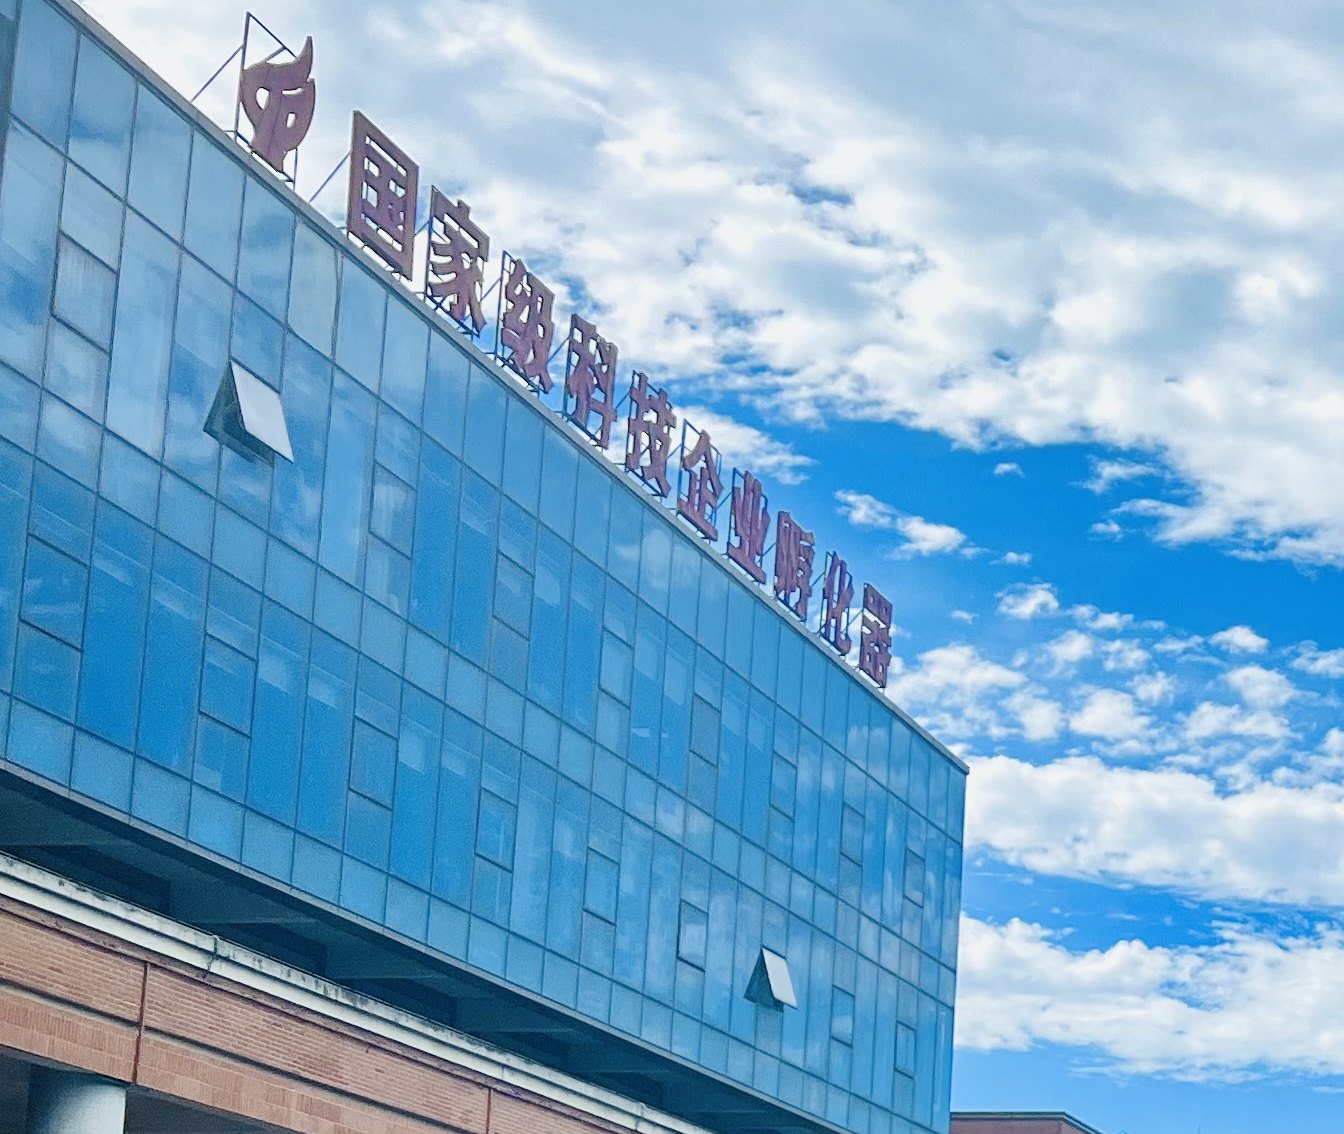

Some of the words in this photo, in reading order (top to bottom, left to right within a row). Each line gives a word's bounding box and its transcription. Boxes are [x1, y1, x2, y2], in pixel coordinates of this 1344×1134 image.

[347, 110, 893, 690] 国家级科技企业孵化器
